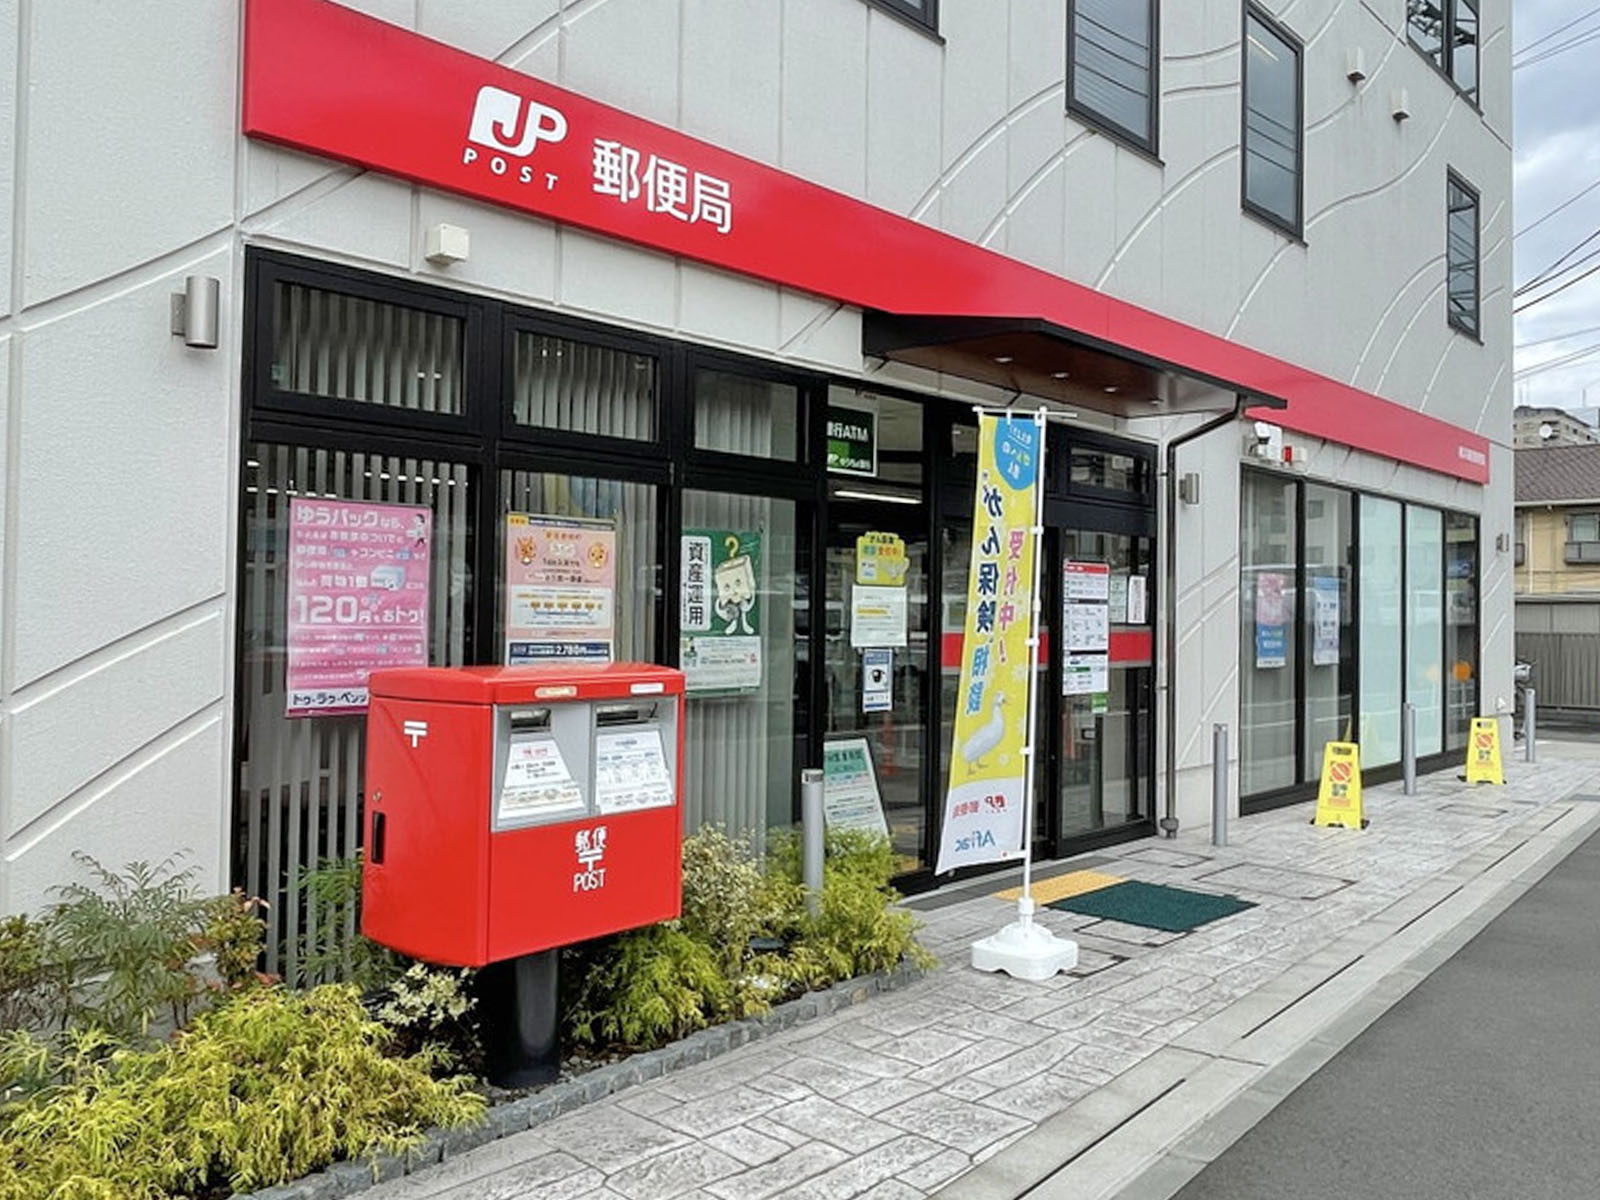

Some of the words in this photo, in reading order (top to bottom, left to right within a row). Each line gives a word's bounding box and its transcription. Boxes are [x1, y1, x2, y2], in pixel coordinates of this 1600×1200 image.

[468, 86, 567, 157] JP
[463, 148, 558, 190] POST
[592, 138, 732, 233] 郵便局
[688, 541, 704, 626] 資産運用
[573, 868, 607, 893] POST
